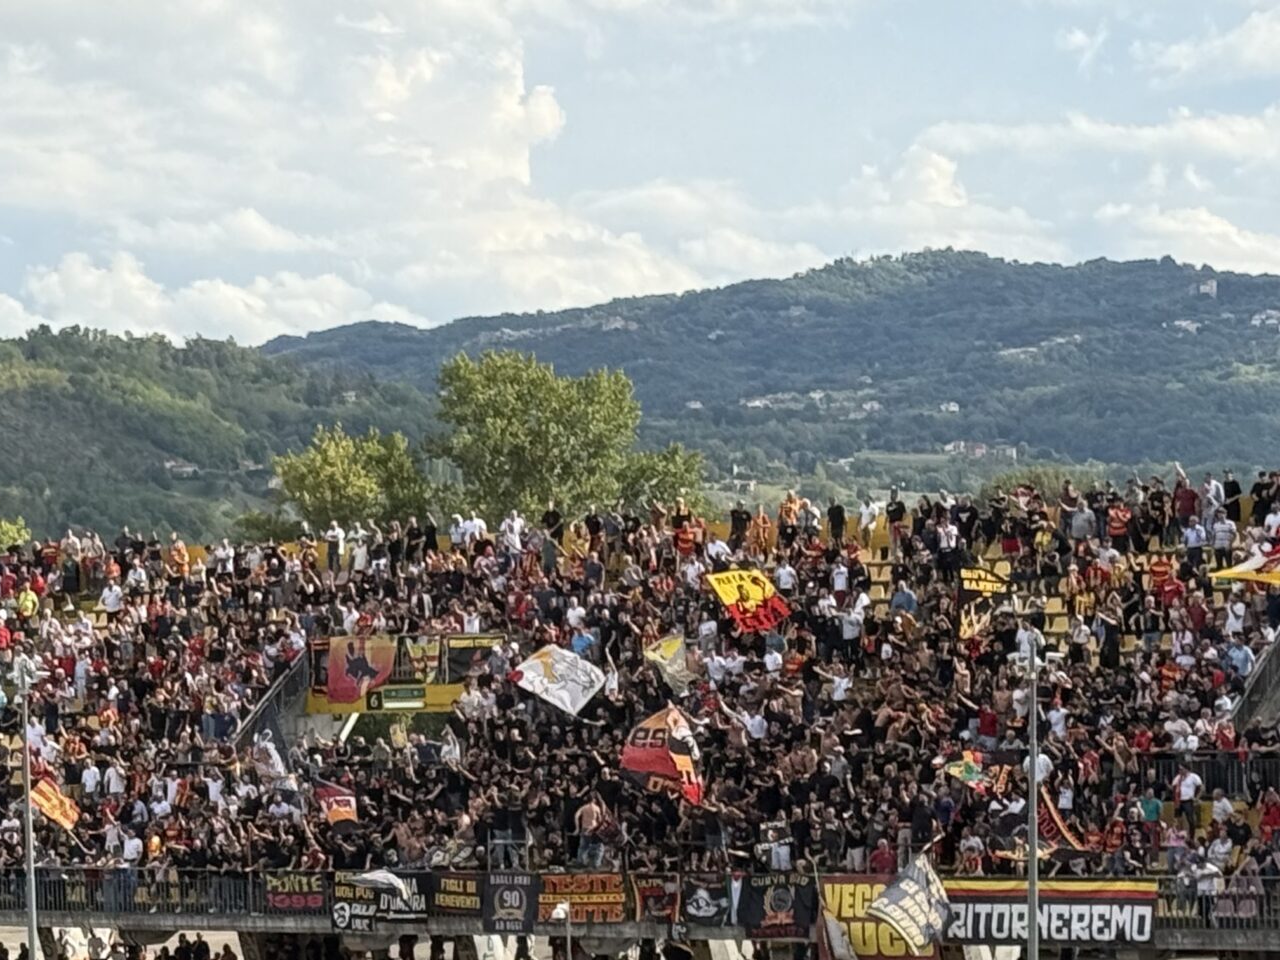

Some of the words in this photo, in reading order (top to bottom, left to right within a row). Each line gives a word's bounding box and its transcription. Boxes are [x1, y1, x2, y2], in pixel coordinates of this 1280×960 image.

[369, 696, 379, 708] 6
[541, 873, 625, 893] TESTE
[503, 890, 520, 908] 90
[537, 904, 626, 923] MTTE
[948, 903, 1153, 942] RITORNEREMO
